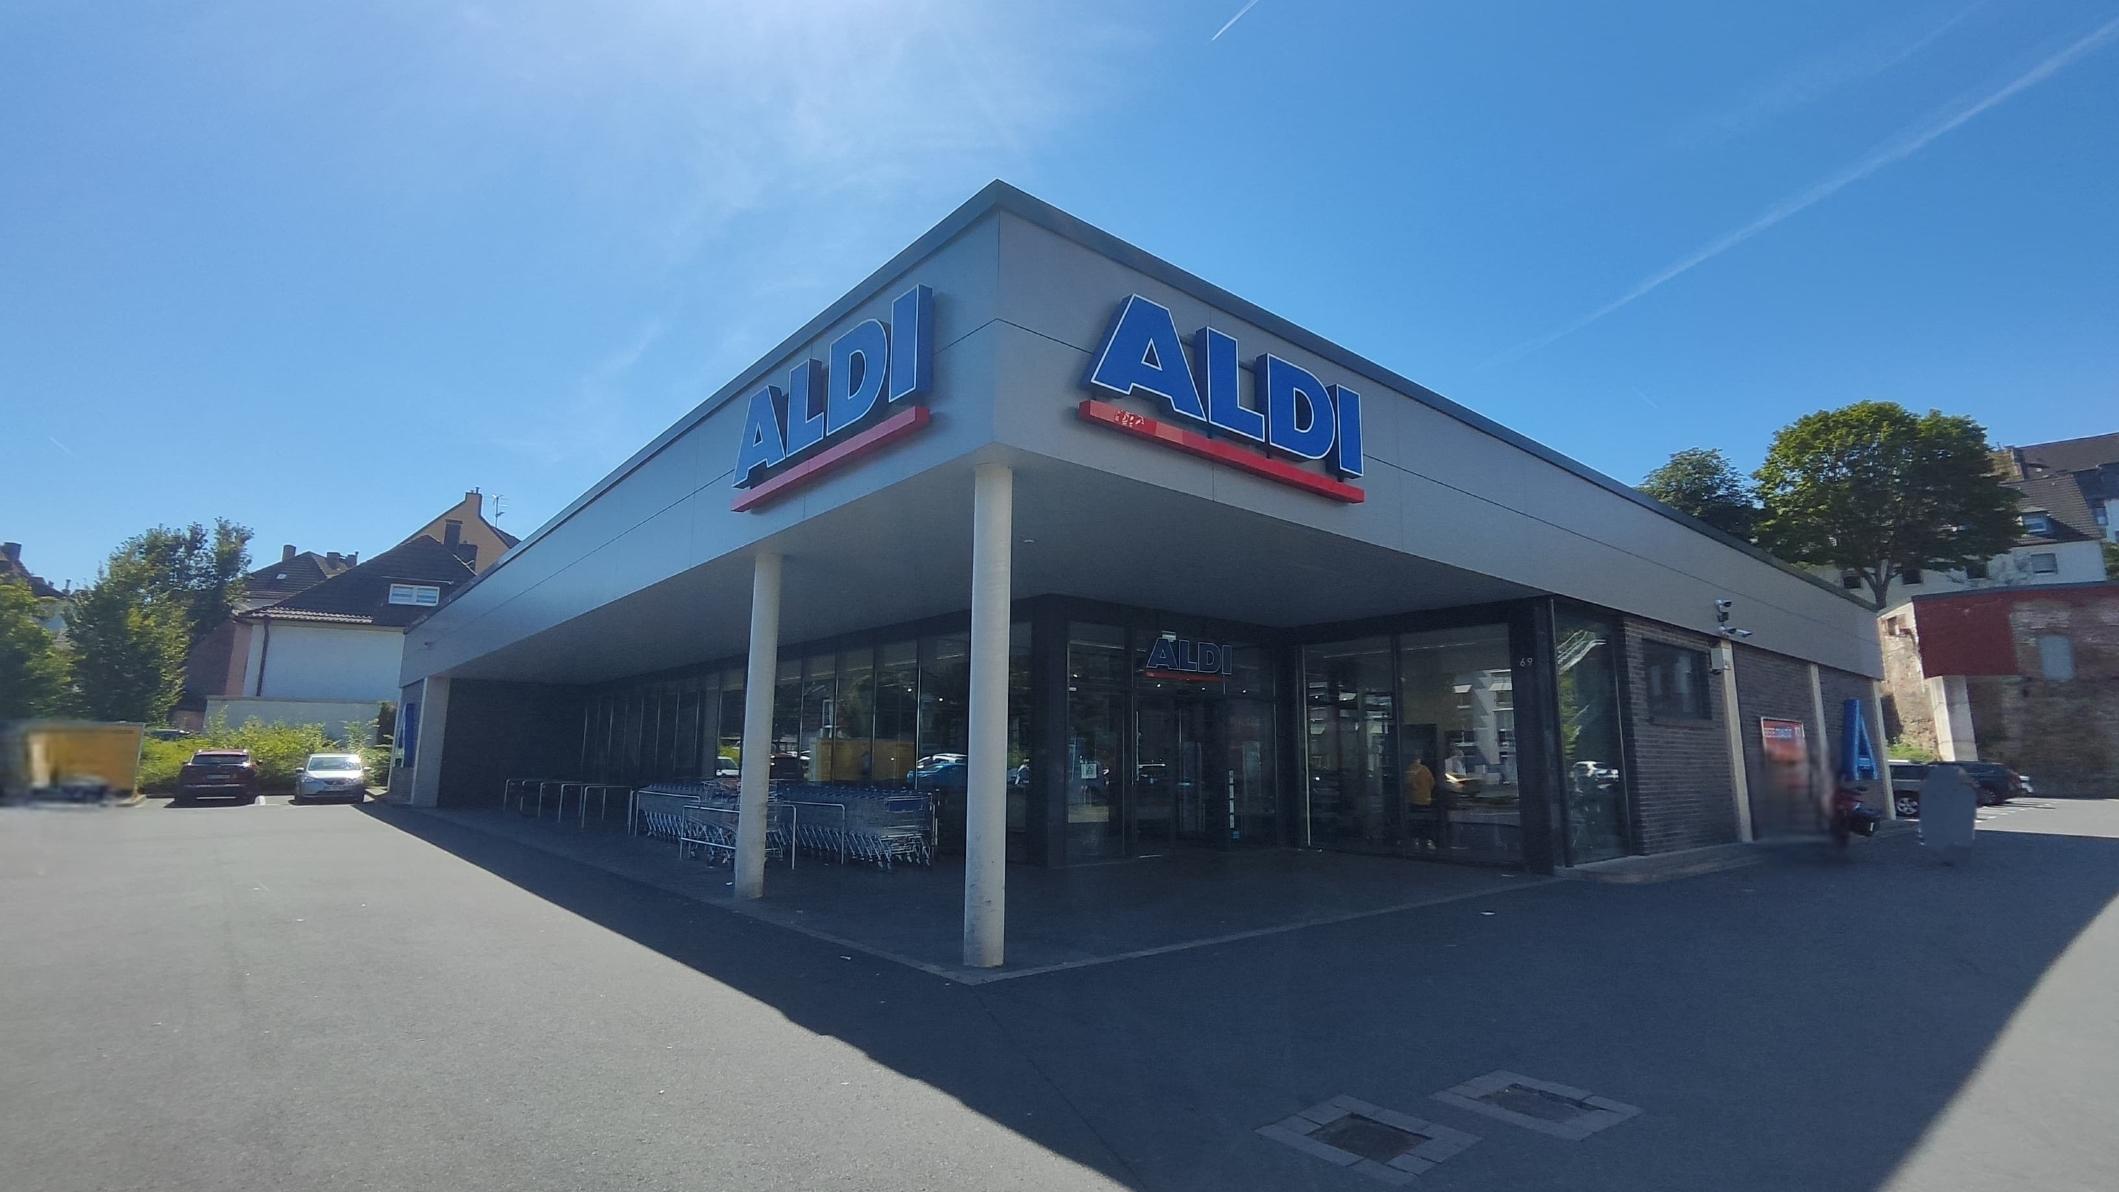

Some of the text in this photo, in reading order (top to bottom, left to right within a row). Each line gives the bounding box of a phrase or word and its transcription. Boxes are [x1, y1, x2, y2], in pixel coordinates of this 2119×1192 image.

[732, 284, 932, 489] ALDI
[1088, 293, 1364, 479] ALDI
[1146, 637, 1233, 675] ALDI
[1520, 657, 1533, 668] 69
